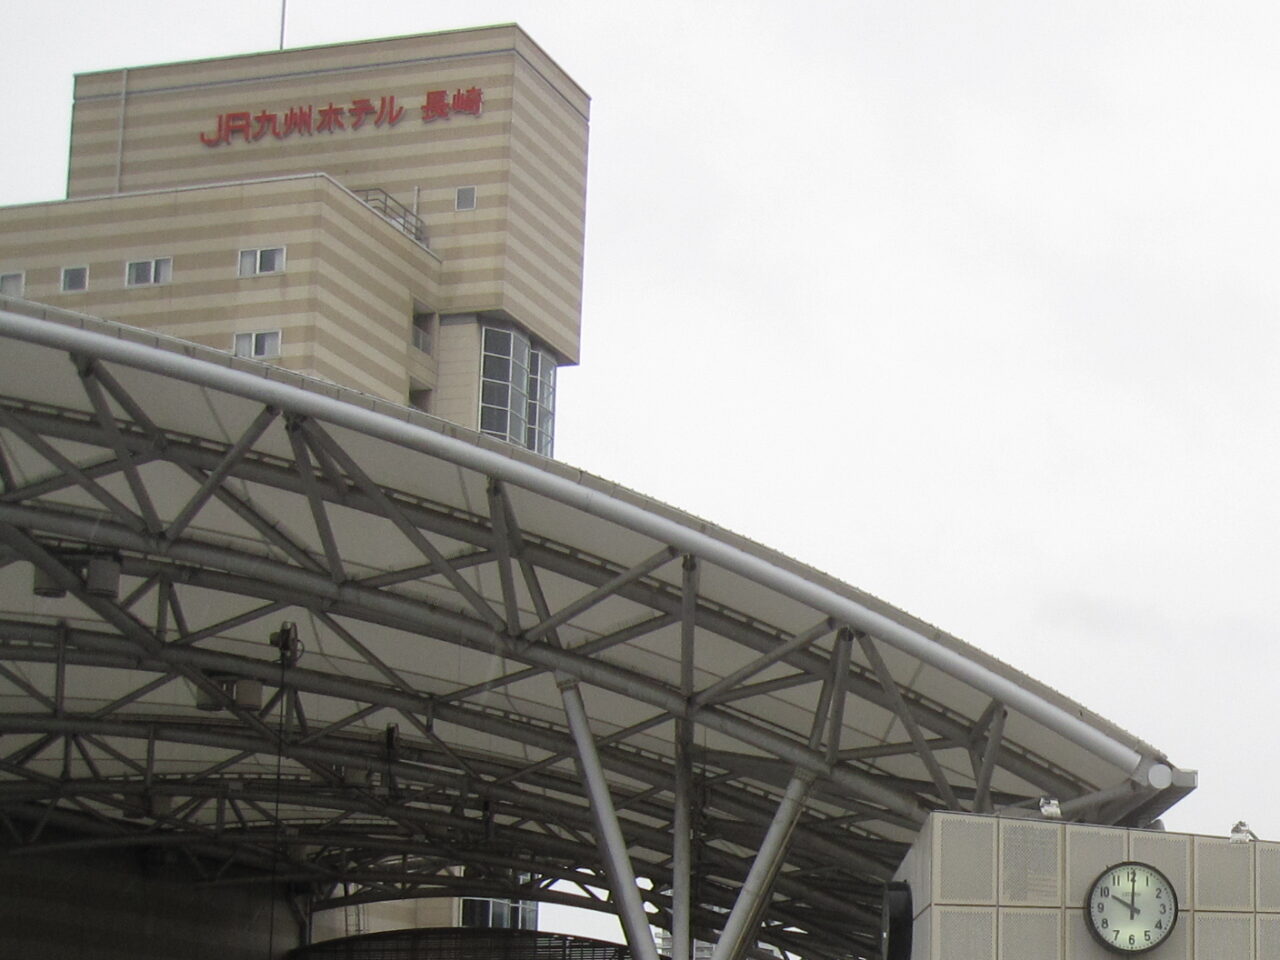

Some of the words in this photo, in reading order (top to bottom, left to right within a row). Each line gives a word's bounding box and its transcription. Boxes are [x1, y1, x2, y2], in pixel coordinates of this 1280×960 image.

[200, 95, 404, 148] JR九州ホテル
[421, 86, 484, 122] 長崎
[1100, 886, 1109, 898] 10
[1155, 888, 1162, 898] 2
[1098, 903, 1104, 913] 9
[1160, 904, 1166, 914] 3
[1101, 919, 1108, 928] 8
[1155, 920, 1162, 930] 4
[1112, 930, 1120, 940] 7
[1128, 935, 1135, 945] 6
[1144, 930, 1151, 941] 5
